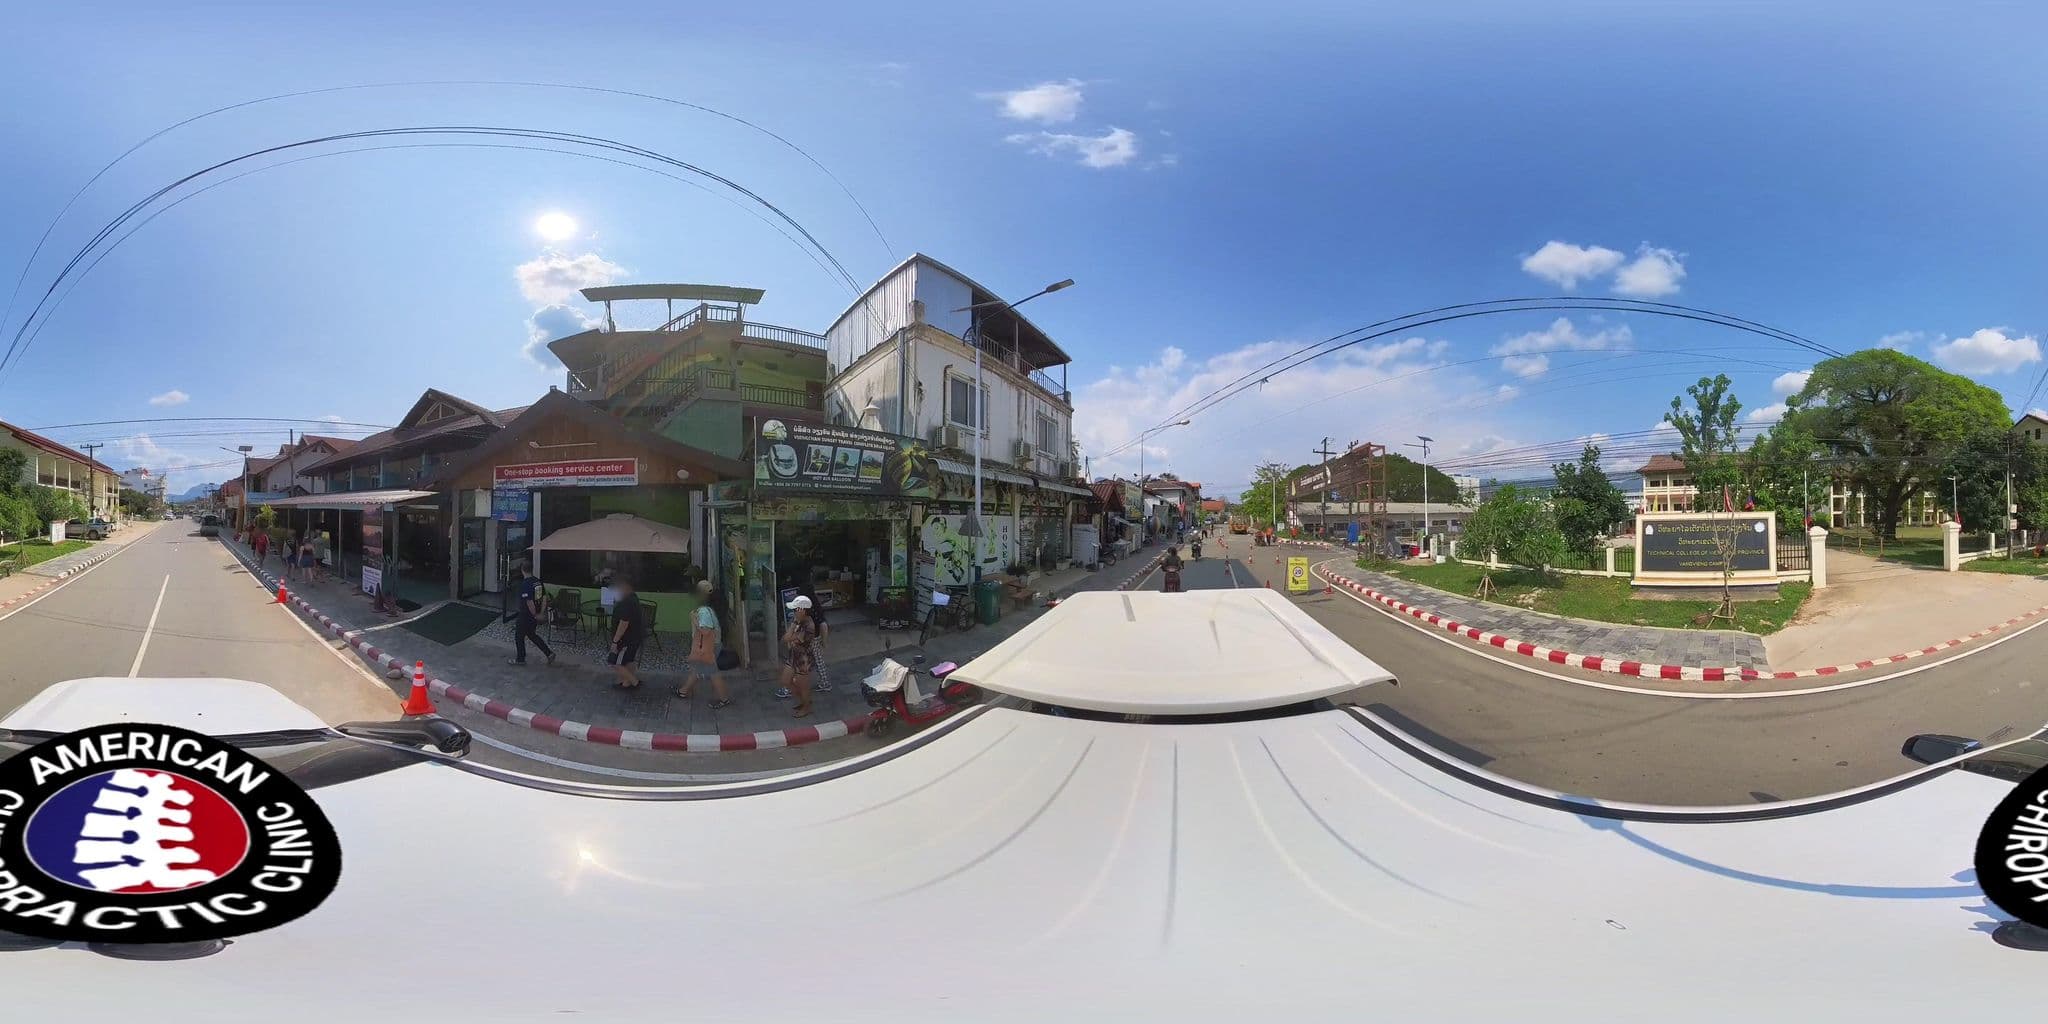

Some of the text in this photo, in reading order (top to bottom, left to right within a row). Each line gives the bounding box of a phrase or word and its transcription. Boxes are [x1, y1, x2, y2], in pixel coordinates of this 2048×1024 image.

[504, 463, 623, 477] One-stop booking service center
